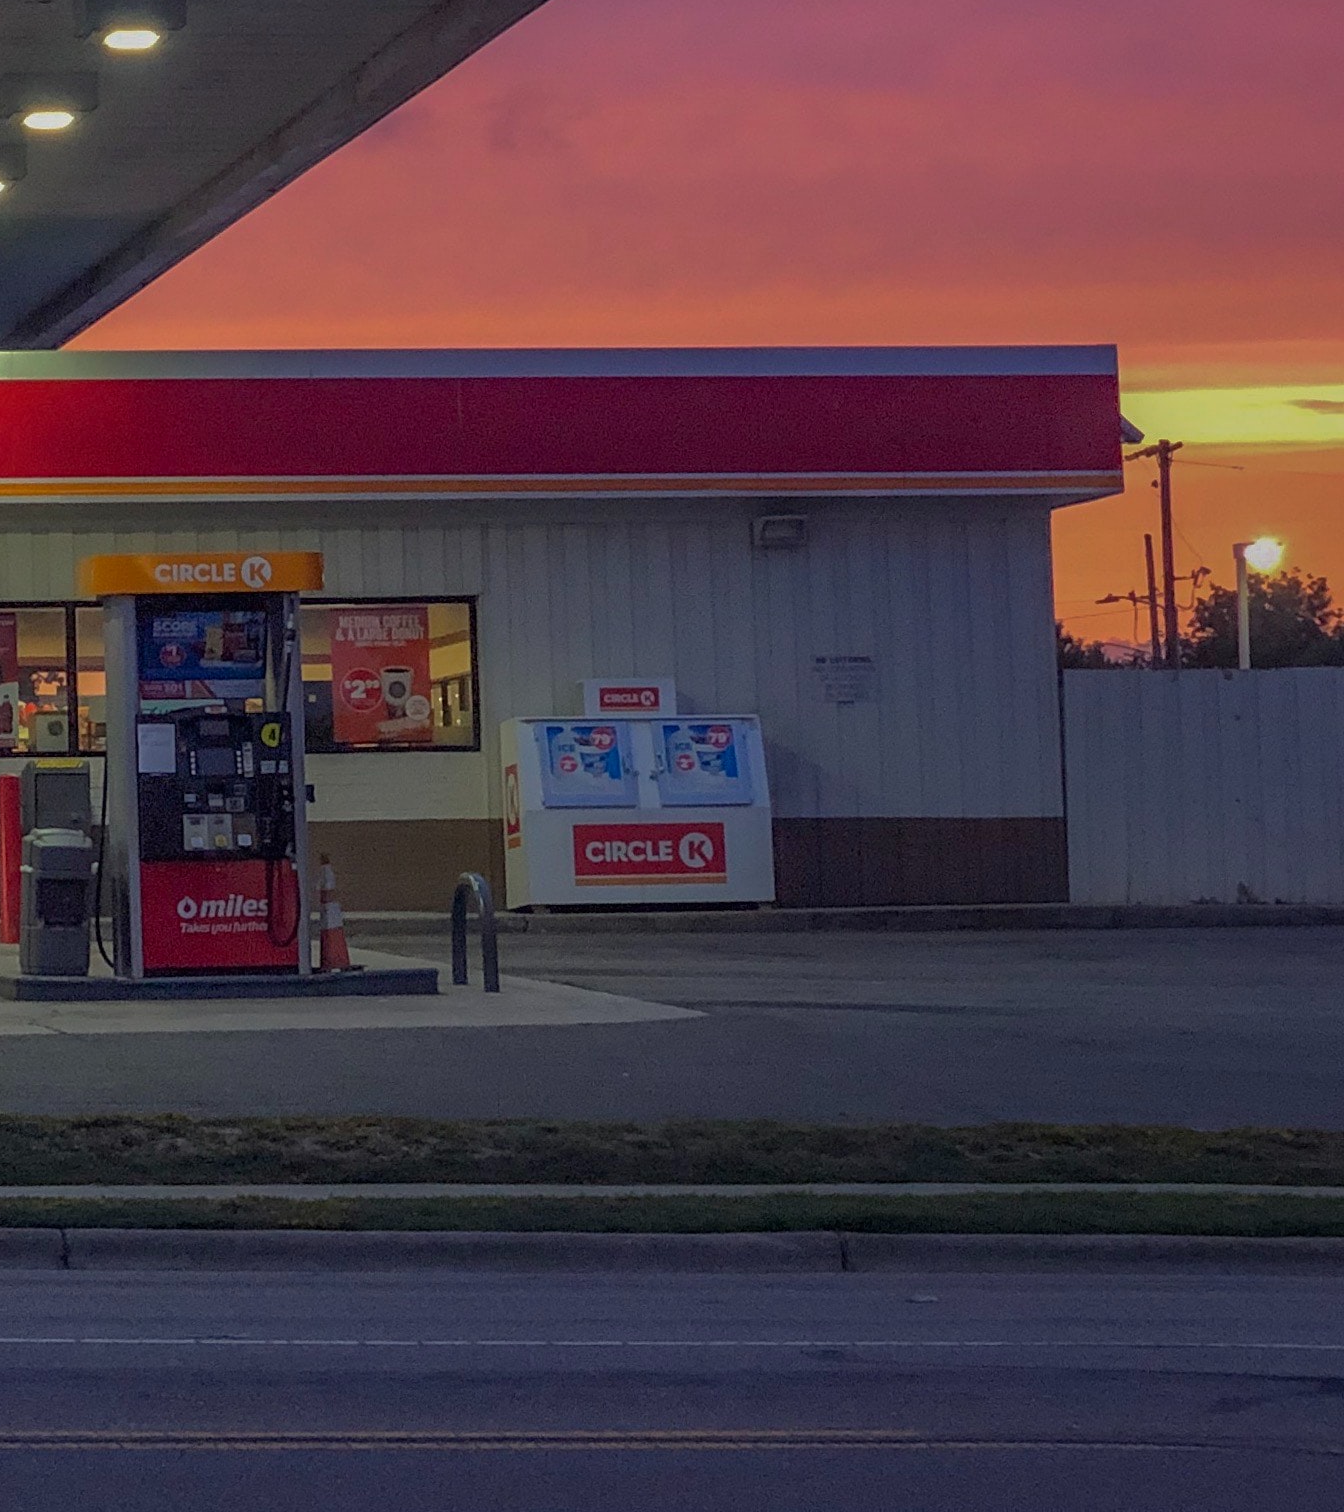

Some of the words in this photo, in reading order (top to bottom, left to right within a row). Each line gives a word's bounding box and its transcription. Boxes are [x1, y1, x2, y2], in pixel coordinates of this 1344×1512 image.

[154, 563, 236, 583] CIRCLE
[382, 614, 420, 628] COFFEE
[603, 693, 640, 703] CIRCLE
[268, 728, 276, 741] 4
[585, 840, 674, 863] CIRCLE
[180, 922, 210, 934] Takes
[211, 922, 232, 935] you
[232, 920, 269, 933] furthe
